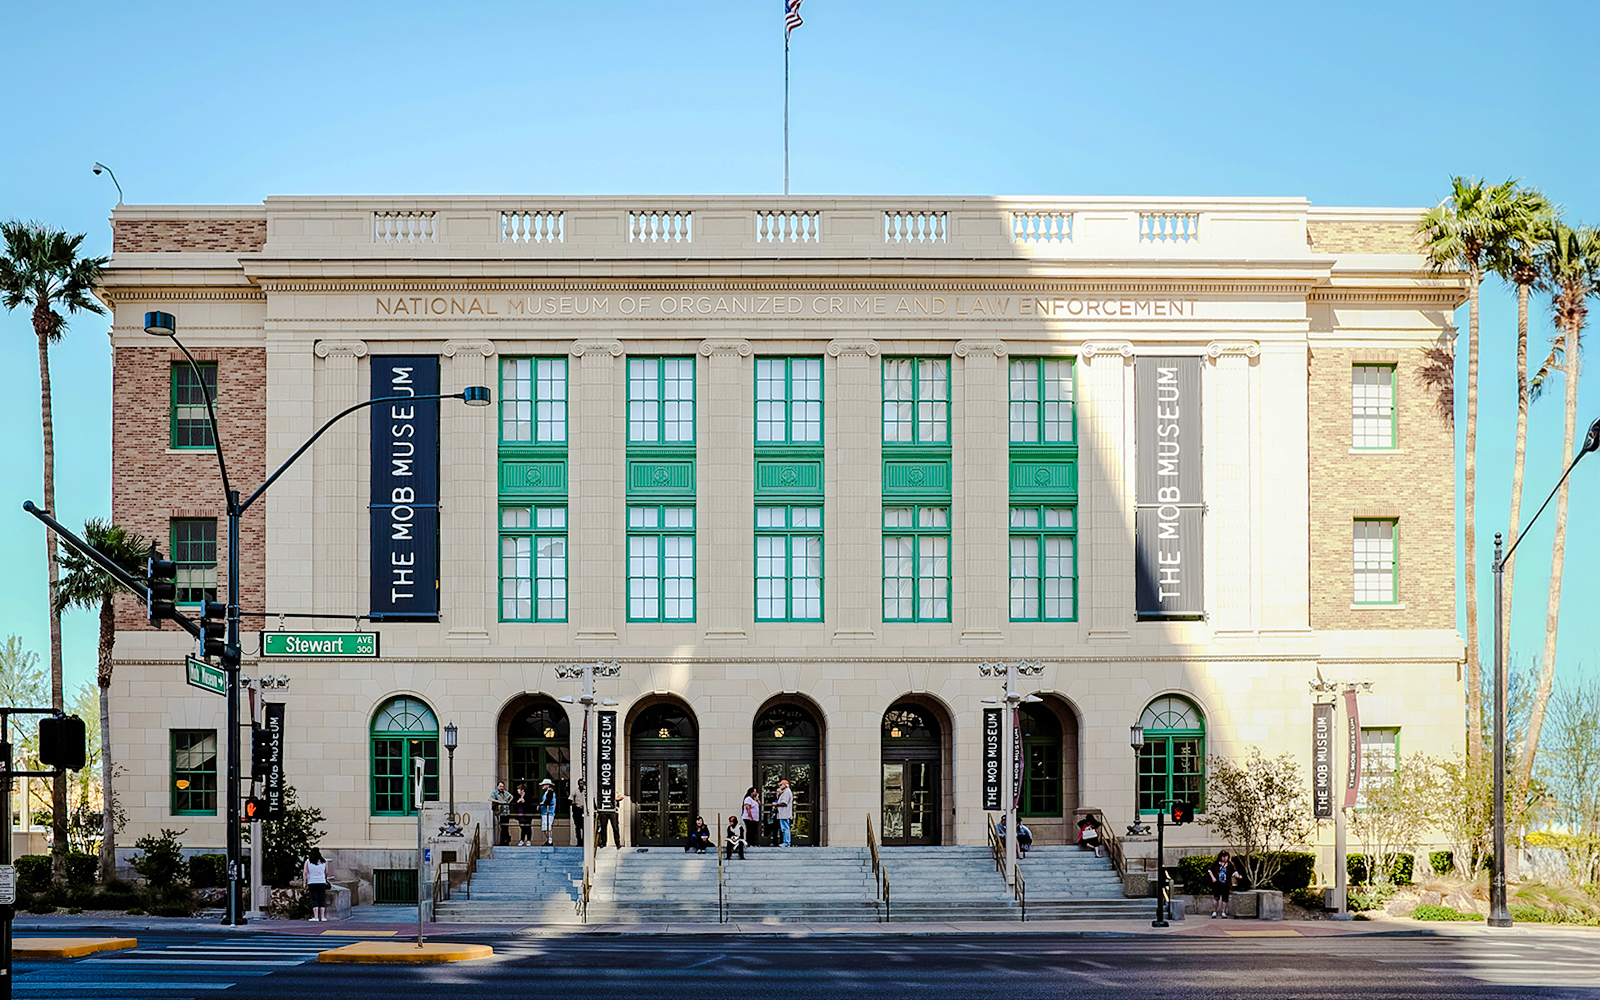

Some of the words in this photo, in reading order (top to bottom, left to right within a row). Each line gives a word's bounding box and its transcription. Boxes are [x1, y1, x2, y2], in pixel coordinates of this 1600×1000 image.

[376, 296, 498, 316] NATIONAL
[507, 296, 609, 316] MUSEUM
[618, 296, 652, 316] OF
[660, 296, 804, 316] ORGANIZED
[811, 296, 886, 316] CRIME
[895, 296, 947, 316] AND
[956, 296, 1010, 316] LAW
[1019, 296, 1198, 316] ENFORCEMENT
[391, 366, 415, 476] MUSEUM
[1156, 367, 1180, 476] MUSEUM
[391, 486, 415, 540] MOB
[1157, 486, 1181, 539] MOB
[391, 552, 415, 604] THE
[1158, 550, 1181, 603] THE
[286, 636, 343, 653] Stewart
[602, 716, 612, 760] MUSEUM
[987, 713, 998, 758] MUSEUM
[1317, 717, 1328, 762] MUSEUM
[602, 762, 612, 786] MOB
[987, 760, 998, 783] MOB
[1317, 764, 1328, 788] MOB
[269, 791, 279, 812] THE
[602, 788, 612, 810] THE
[987, 786, 998, 807] THE
[1318, 790, 1328, 811] THE
